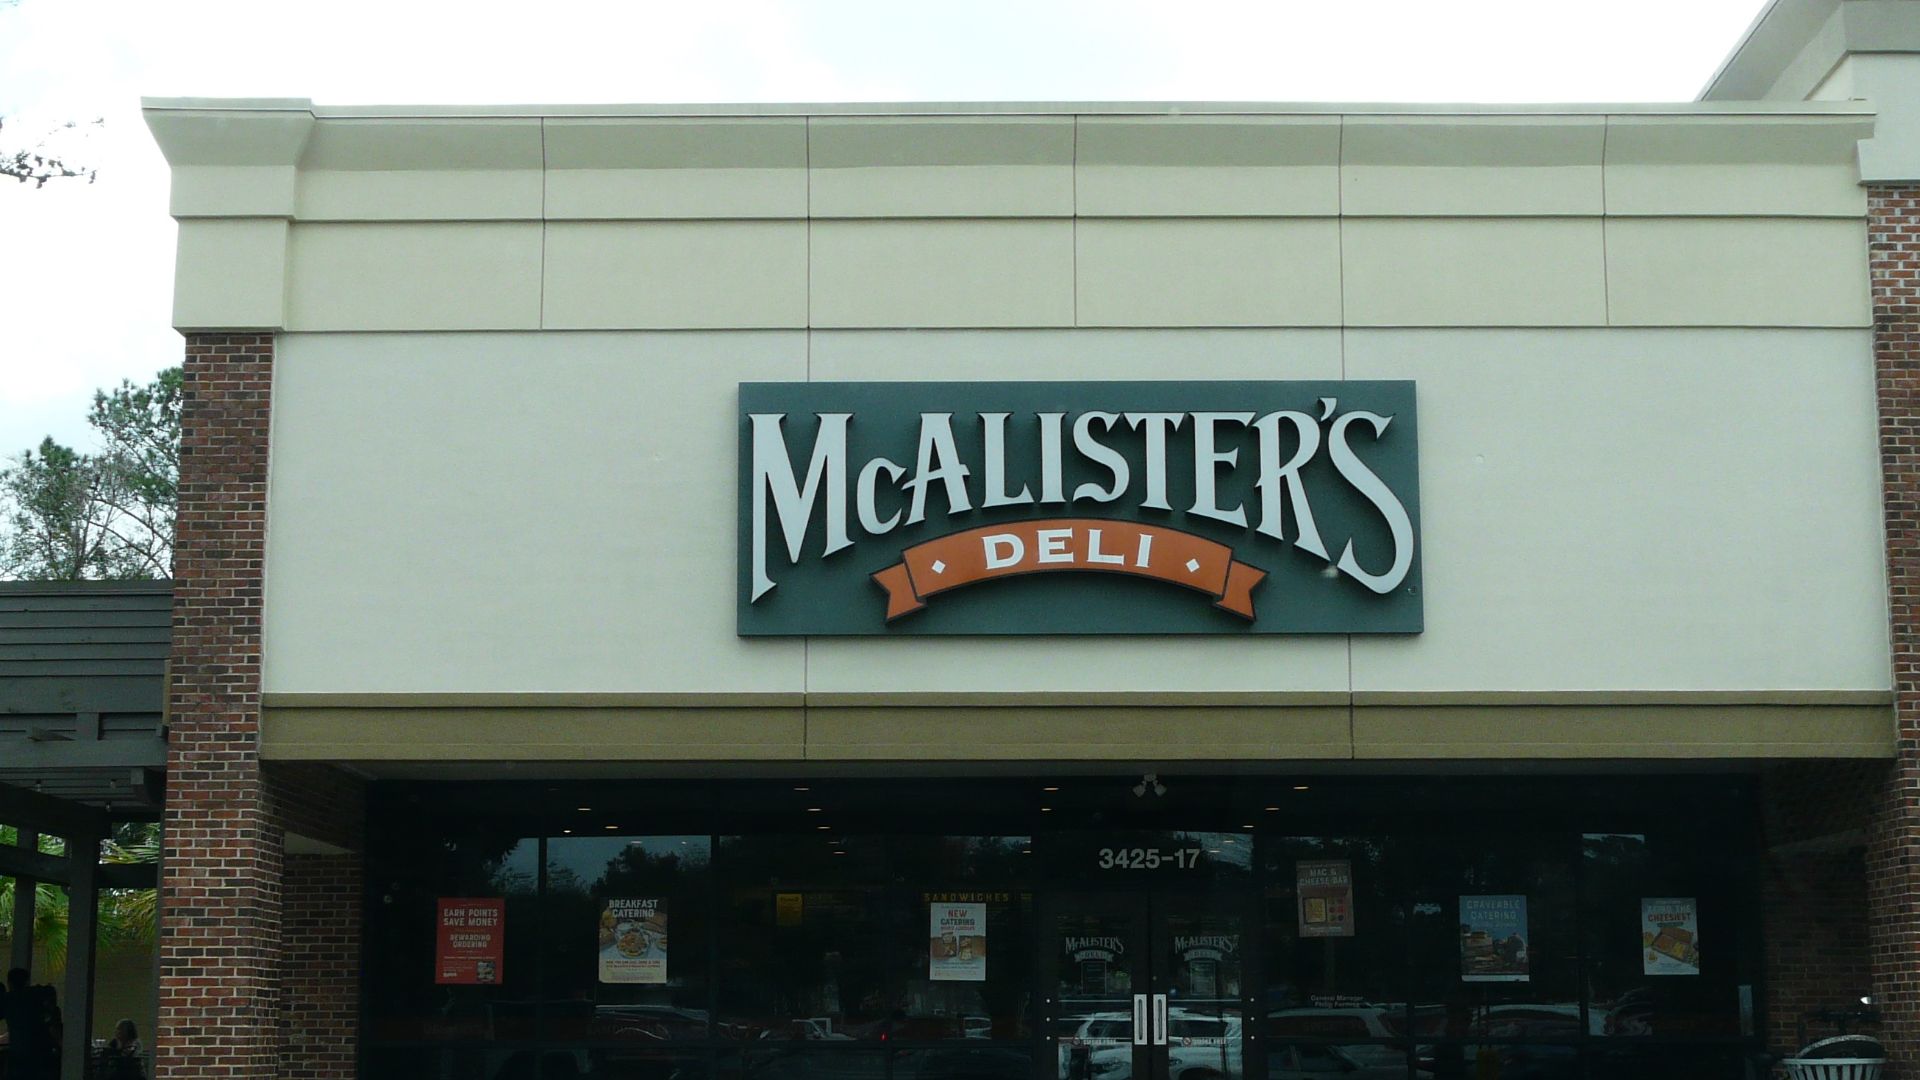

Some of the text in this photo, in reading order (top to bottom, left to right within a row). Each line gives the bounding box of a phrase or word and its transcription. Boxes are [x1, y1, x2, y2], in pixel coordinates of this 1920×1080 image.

[982, 526, 1154, 570] DELI
[1098, 848, 1200, 869] 3425-17
[923, 892, 1009, 902] SANDWICHES
[608, 899, 659, 909] BREAKFAST
[443, 908, 499, 918] EARN POINTS
[612, 909, 655, 919] CATERING
[948, 909, 967, 918] NEW
[443, 917, 498, 927] SAVE MONEY
[940, 918, 975, 926] CATERING
